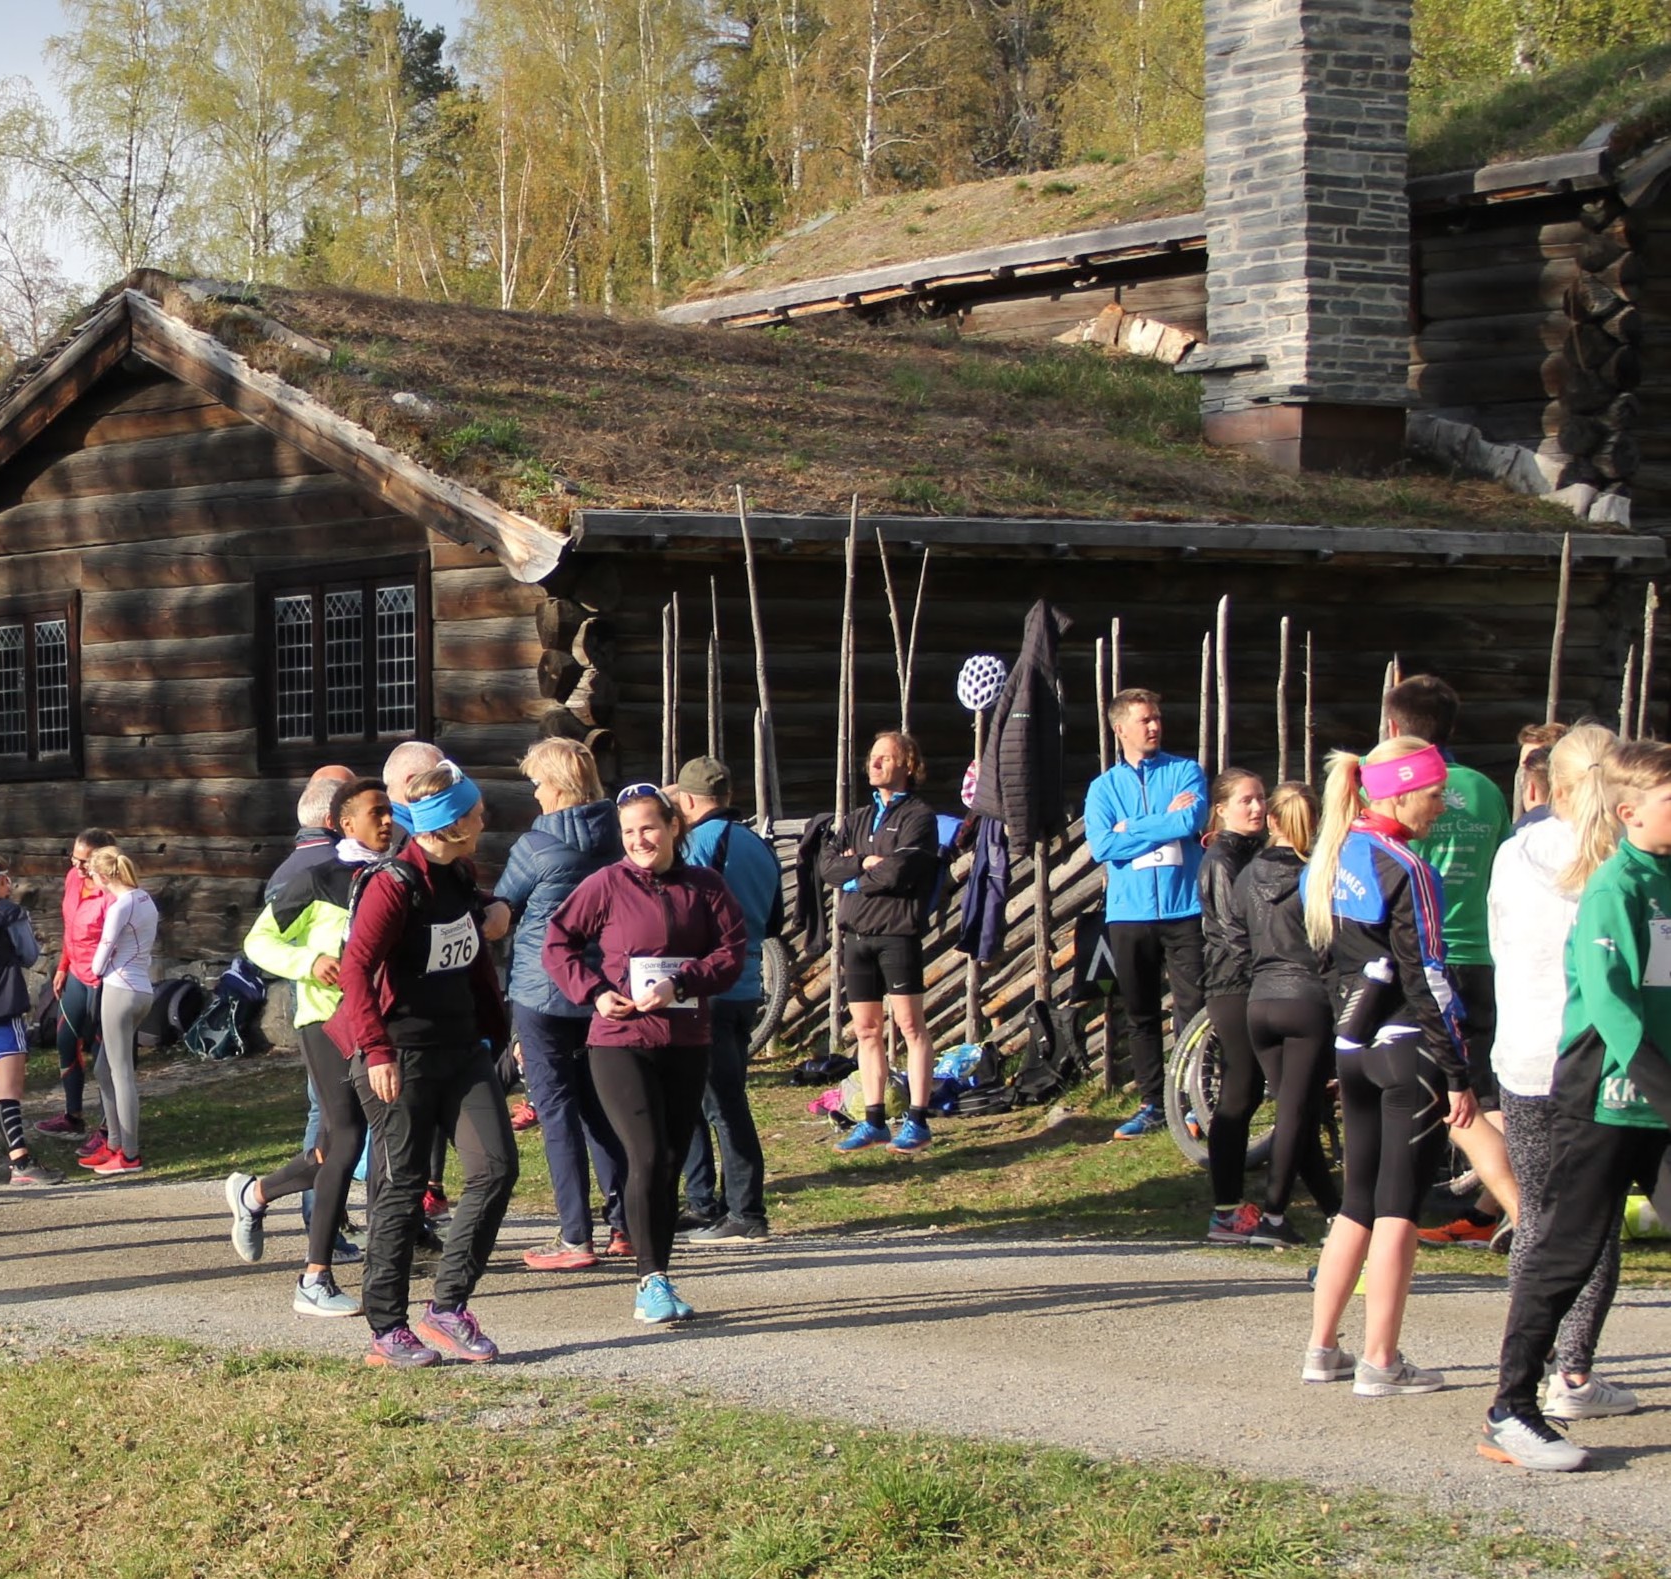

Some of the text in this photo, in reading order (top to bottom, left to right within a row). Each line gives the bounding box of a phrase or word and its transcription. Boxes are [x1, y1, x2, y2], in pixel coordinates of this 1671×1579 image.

[1456, 819, 1493, 835] Casey
[439, 936, 472, 969] 376
[639, 961, 679, 969] SpareBank
